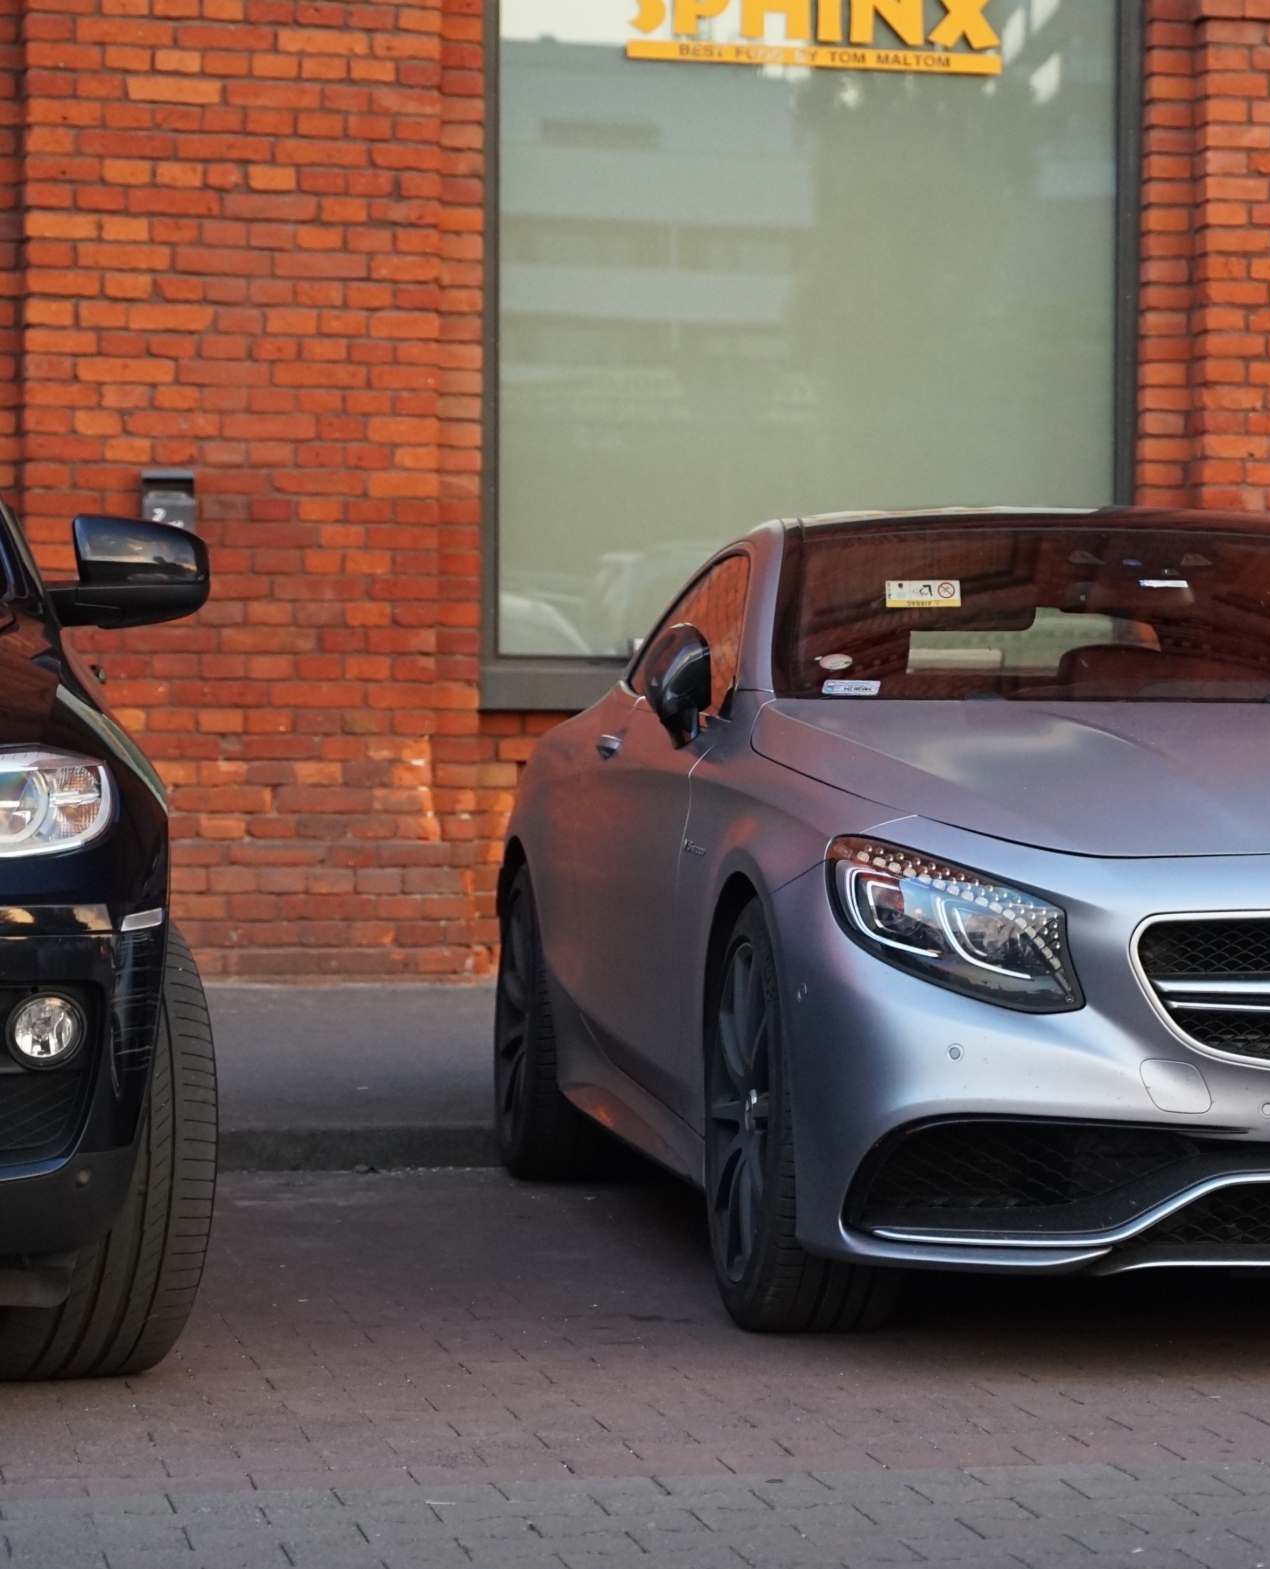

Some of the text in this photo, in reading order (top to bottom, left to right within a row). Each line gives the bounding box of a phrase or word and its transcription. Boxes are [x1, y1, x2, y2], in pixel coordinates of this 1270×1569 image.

[679, 43, 724, 58] BEST
[830, 51, 866, 65] TOM
[876, 53, 950, 68] MALTOM
